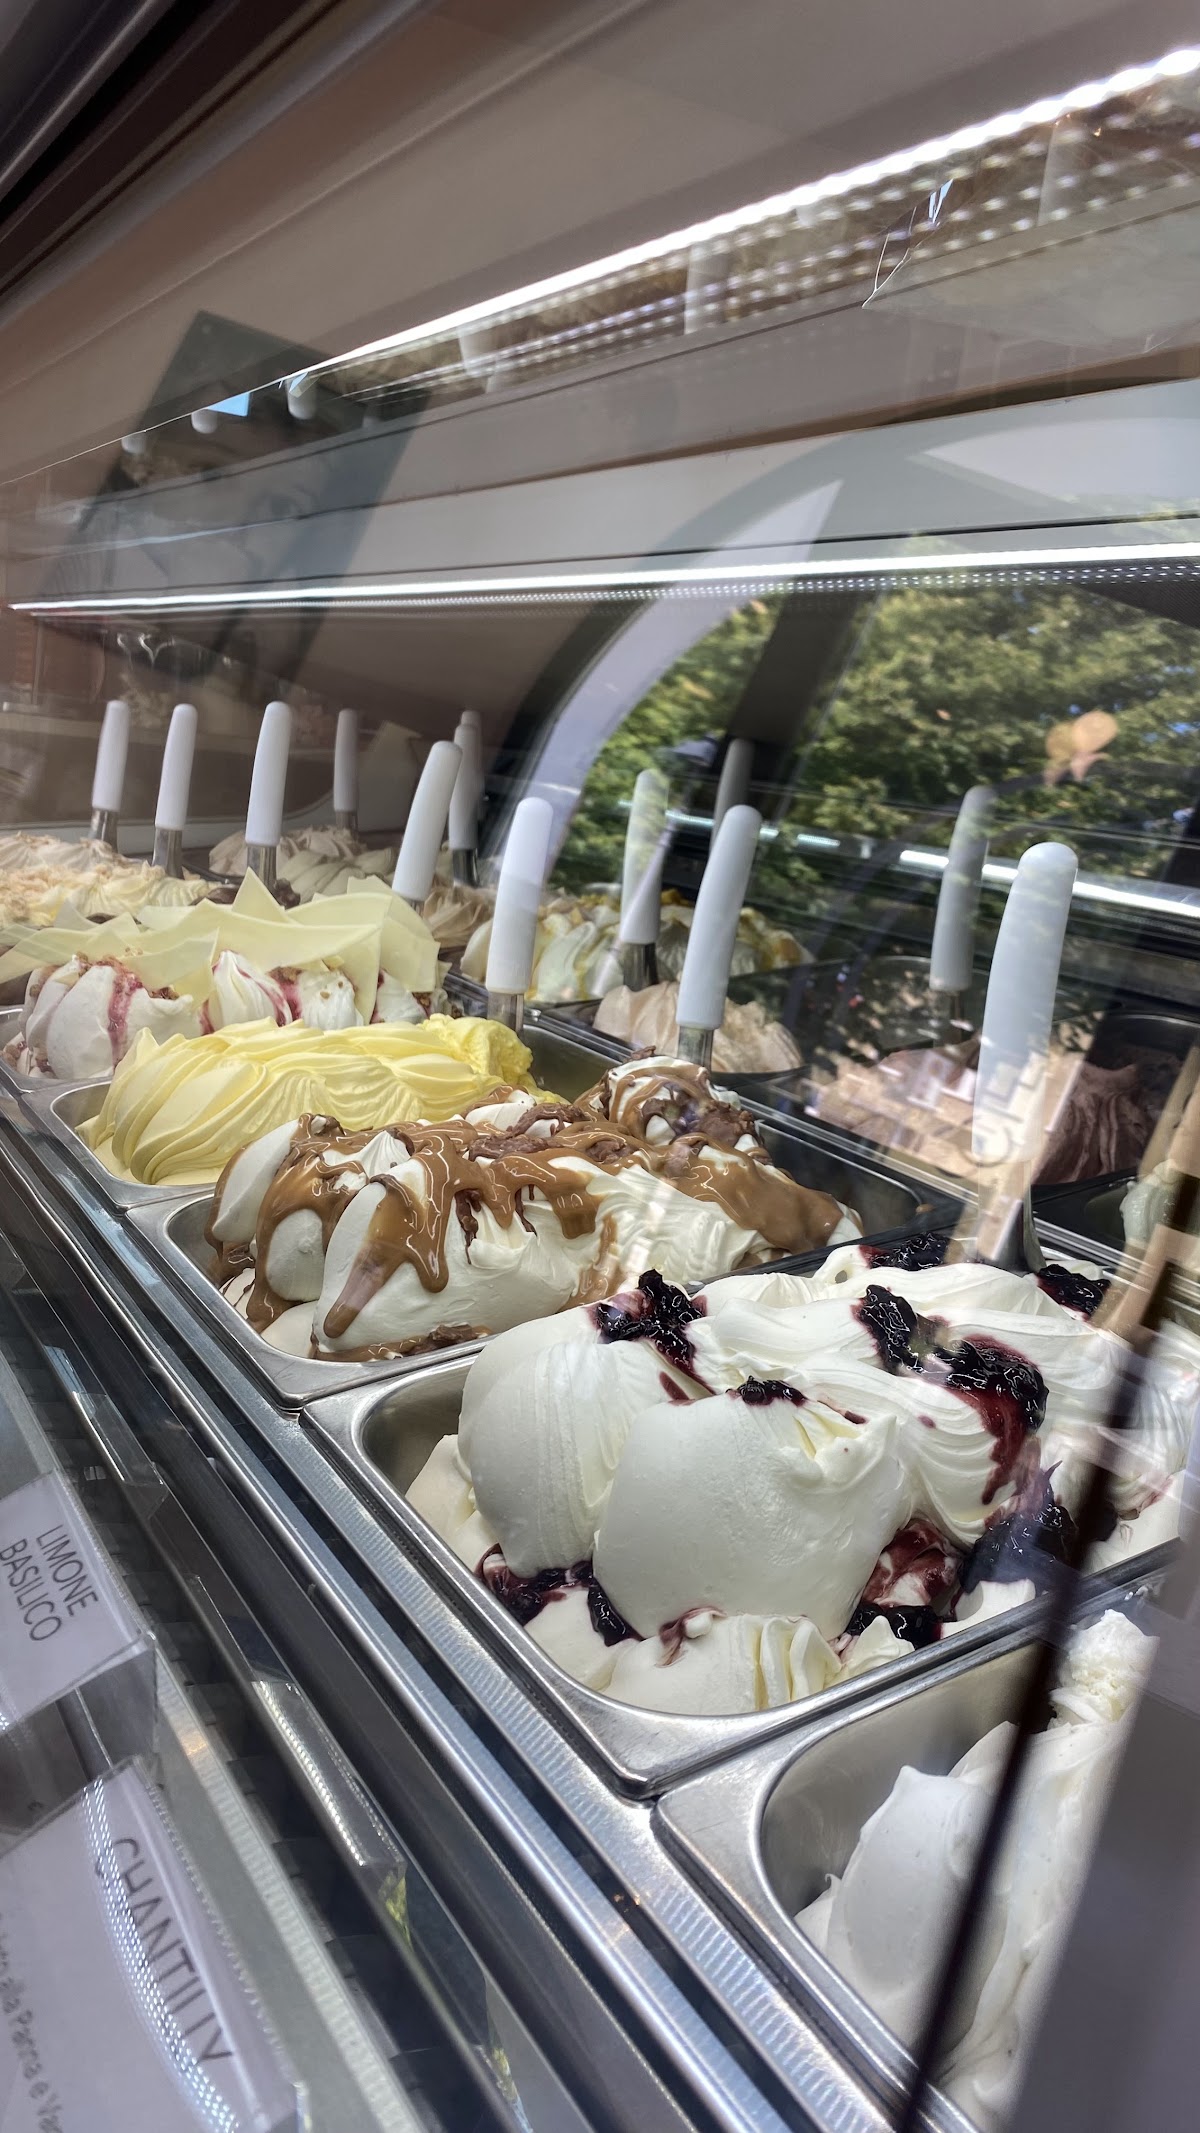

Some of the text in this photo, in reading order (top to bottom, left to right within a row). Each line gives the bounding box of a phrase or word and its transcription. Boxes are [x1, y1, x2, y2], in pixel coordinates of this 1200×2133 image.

[0, 1538, 63, 1642] BASILICO
[36, 1524, 98, 1617] LIMONE
[95, 1837, 233, 2072] CHANTILLY
